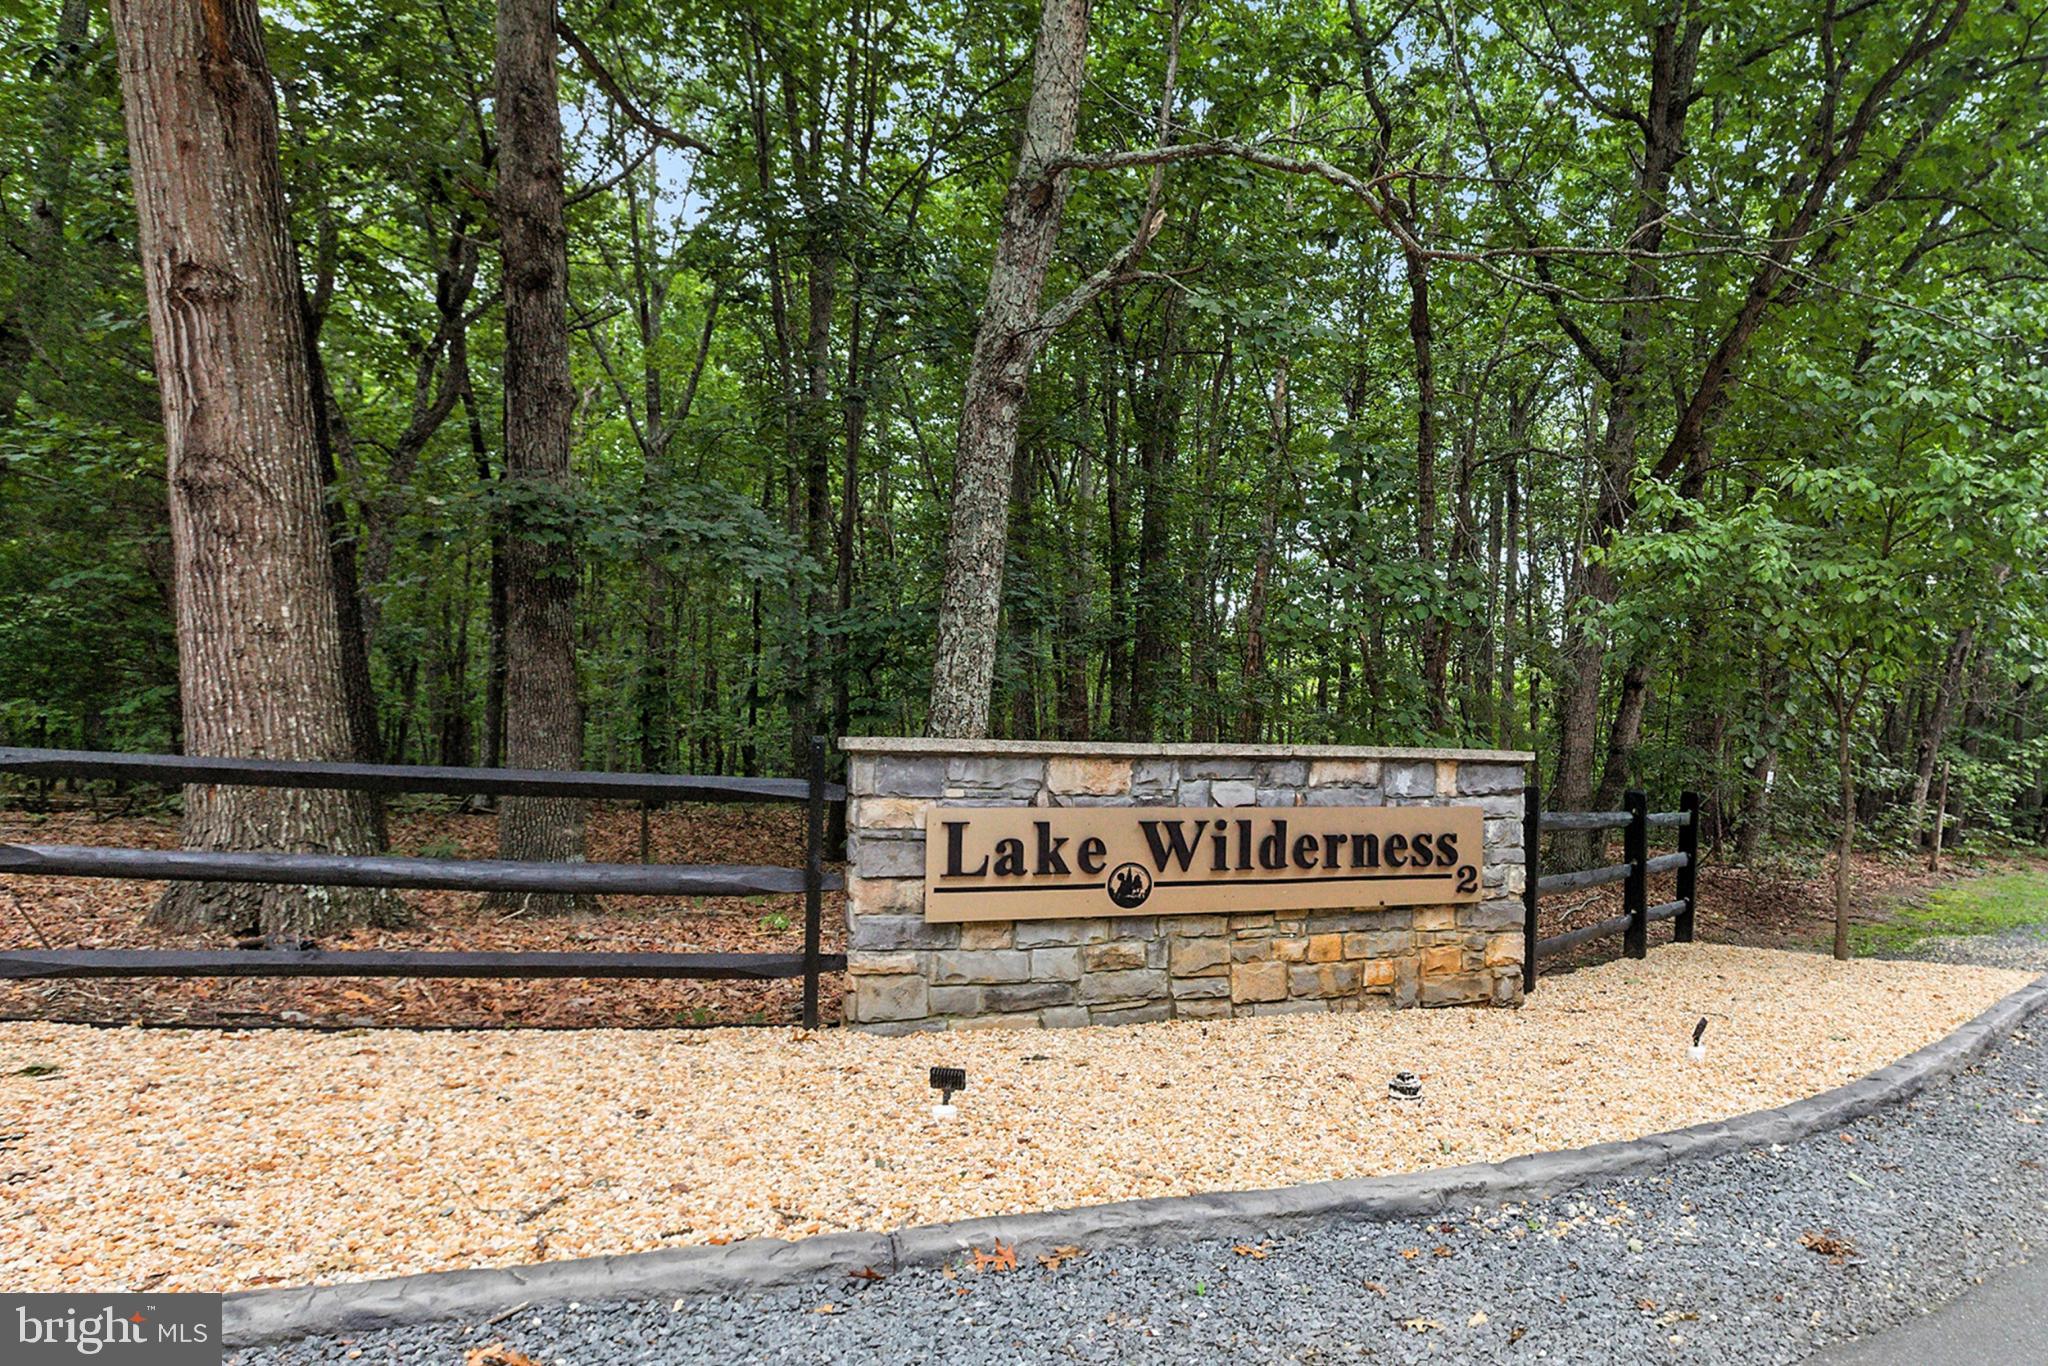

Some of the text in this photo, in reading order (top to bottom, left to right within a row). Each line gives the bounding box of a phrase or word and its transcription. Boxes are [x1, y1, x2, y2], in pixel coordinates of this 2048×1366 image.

[939, 818, 1460, 881] Lake Wilderness
[1455, 864, 1479, 897] 2
